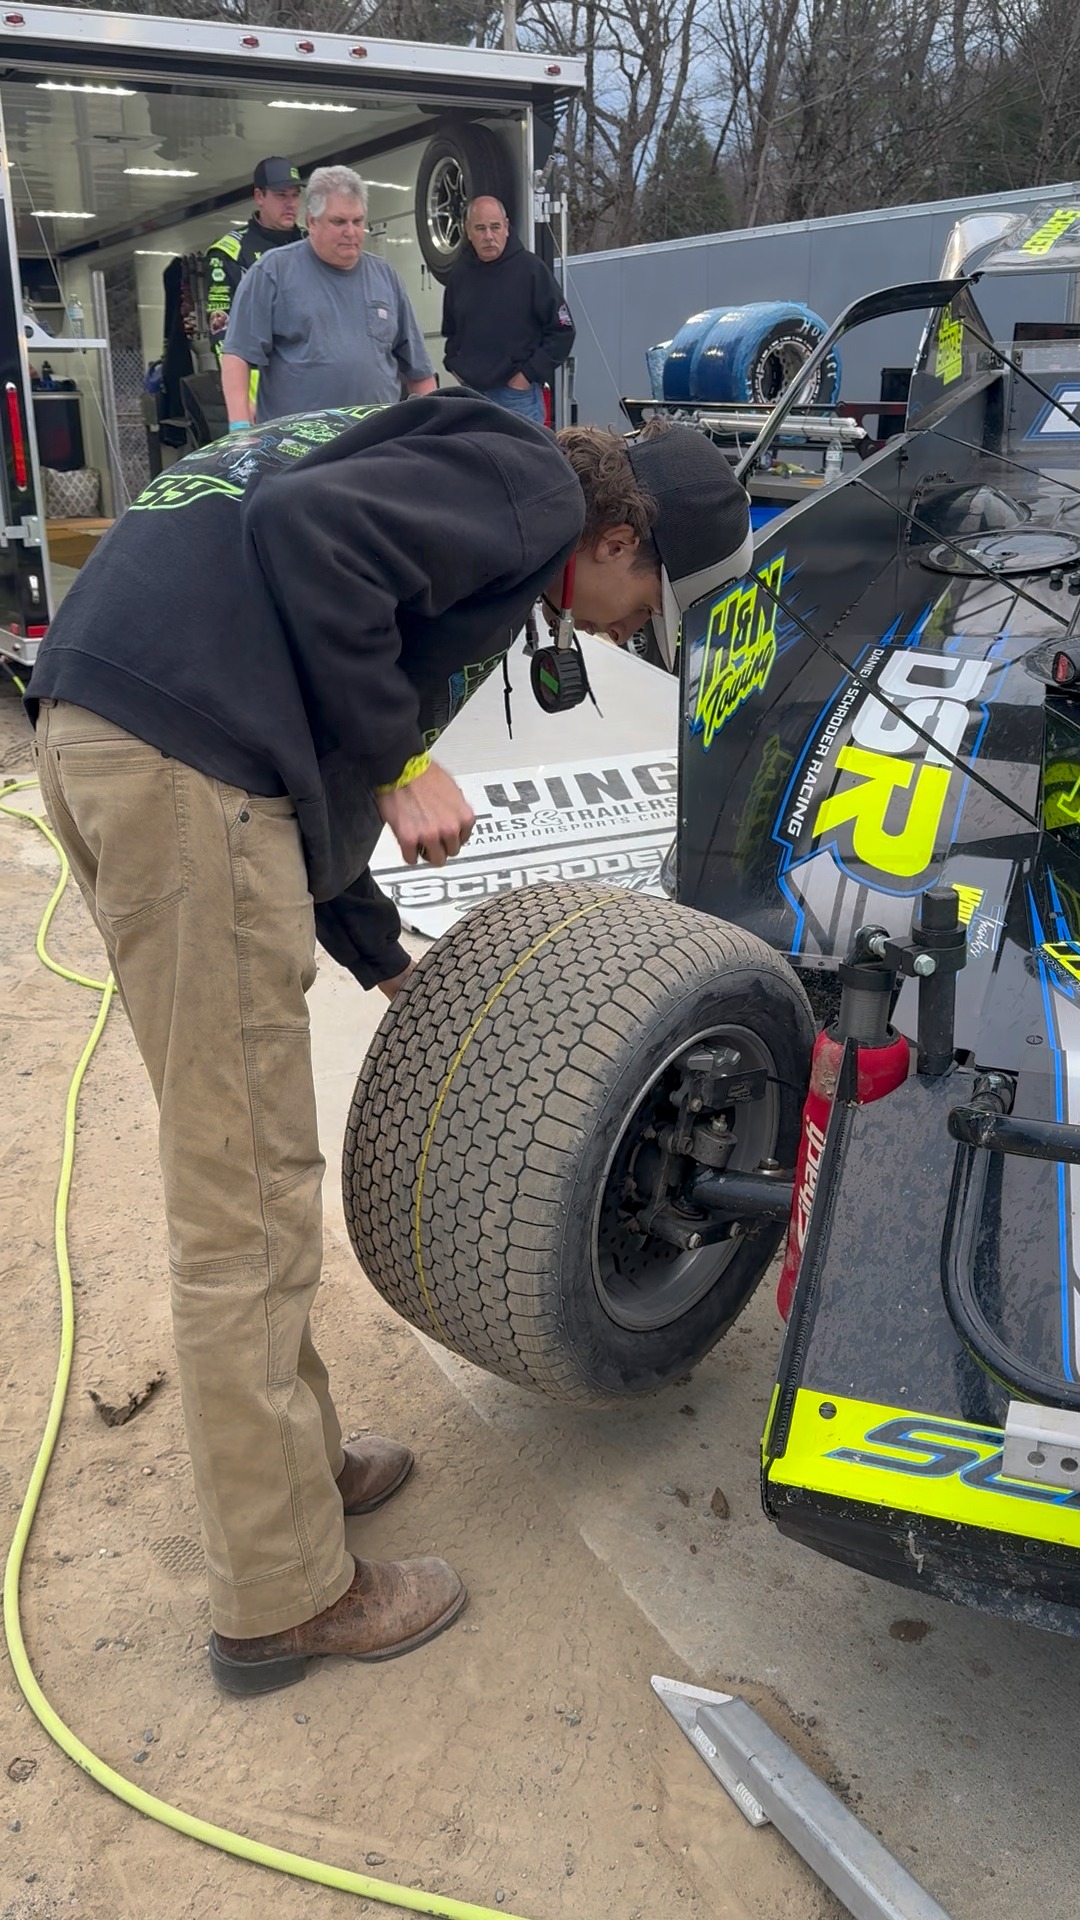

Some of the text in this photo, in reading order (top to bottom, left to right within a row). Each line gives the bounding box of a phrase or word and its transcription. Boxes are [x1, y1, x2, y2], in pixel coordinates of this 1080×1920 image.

[703, 638, 776, 746] Towing
[815, 688, 860, 757] SCHRODER
[787, 759, 823, 838] RACING
[812, 651, 992, 877] DSR
